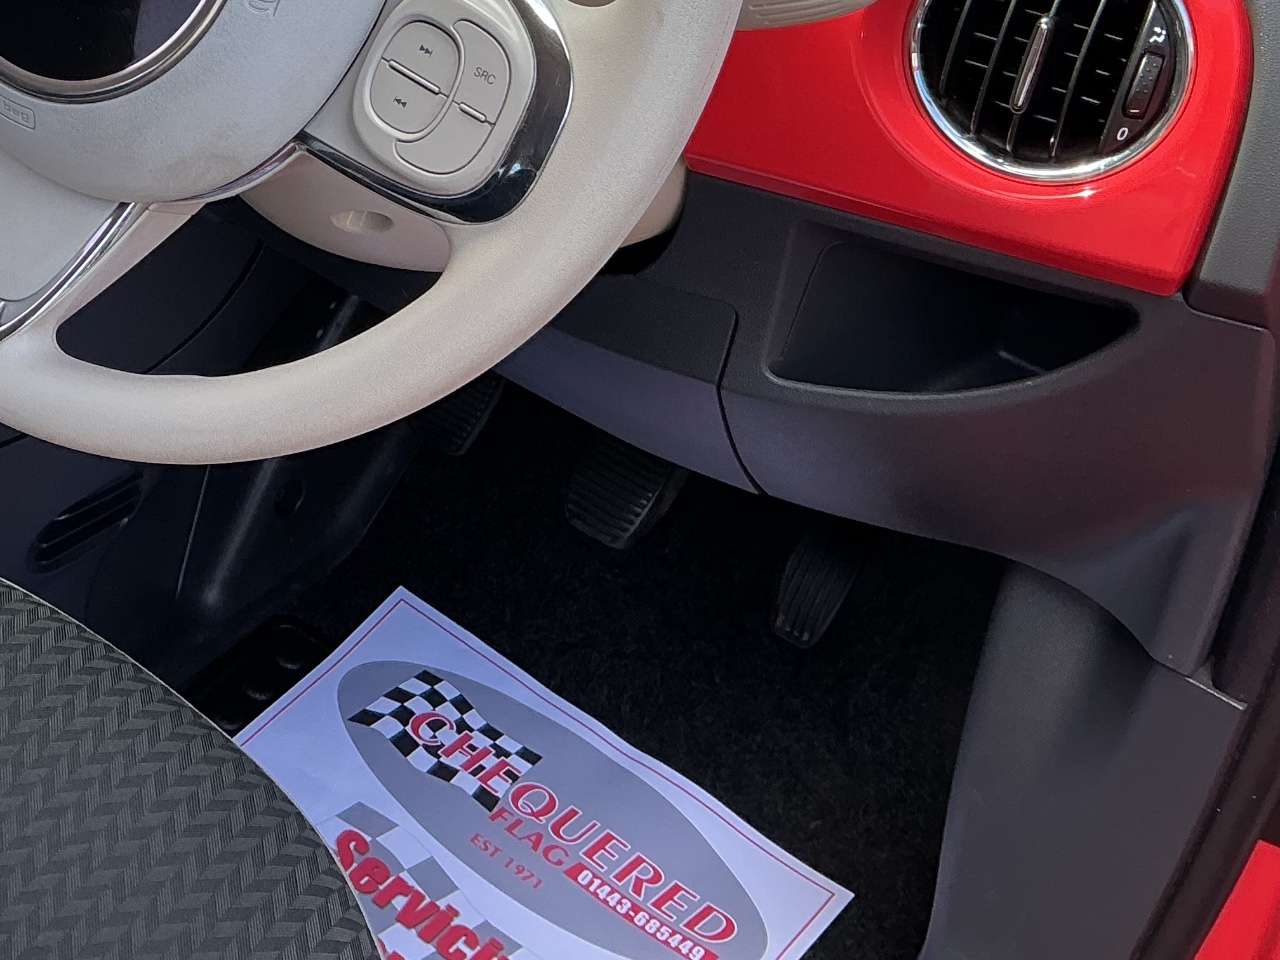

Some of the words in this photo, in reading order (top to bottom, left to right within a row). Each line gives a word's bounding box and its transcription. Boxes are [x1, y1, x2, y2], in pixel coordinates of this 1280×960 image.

[473, 66, 497, 86] SRC
[408, 710, 738, 944] CHEQUERED
[488, 805, 570, 867] FLAG
[468, 832, 504, 858] EST
[504, 856, 545, 890] 1971
[576, 869, 706, 960] 01443-685449
